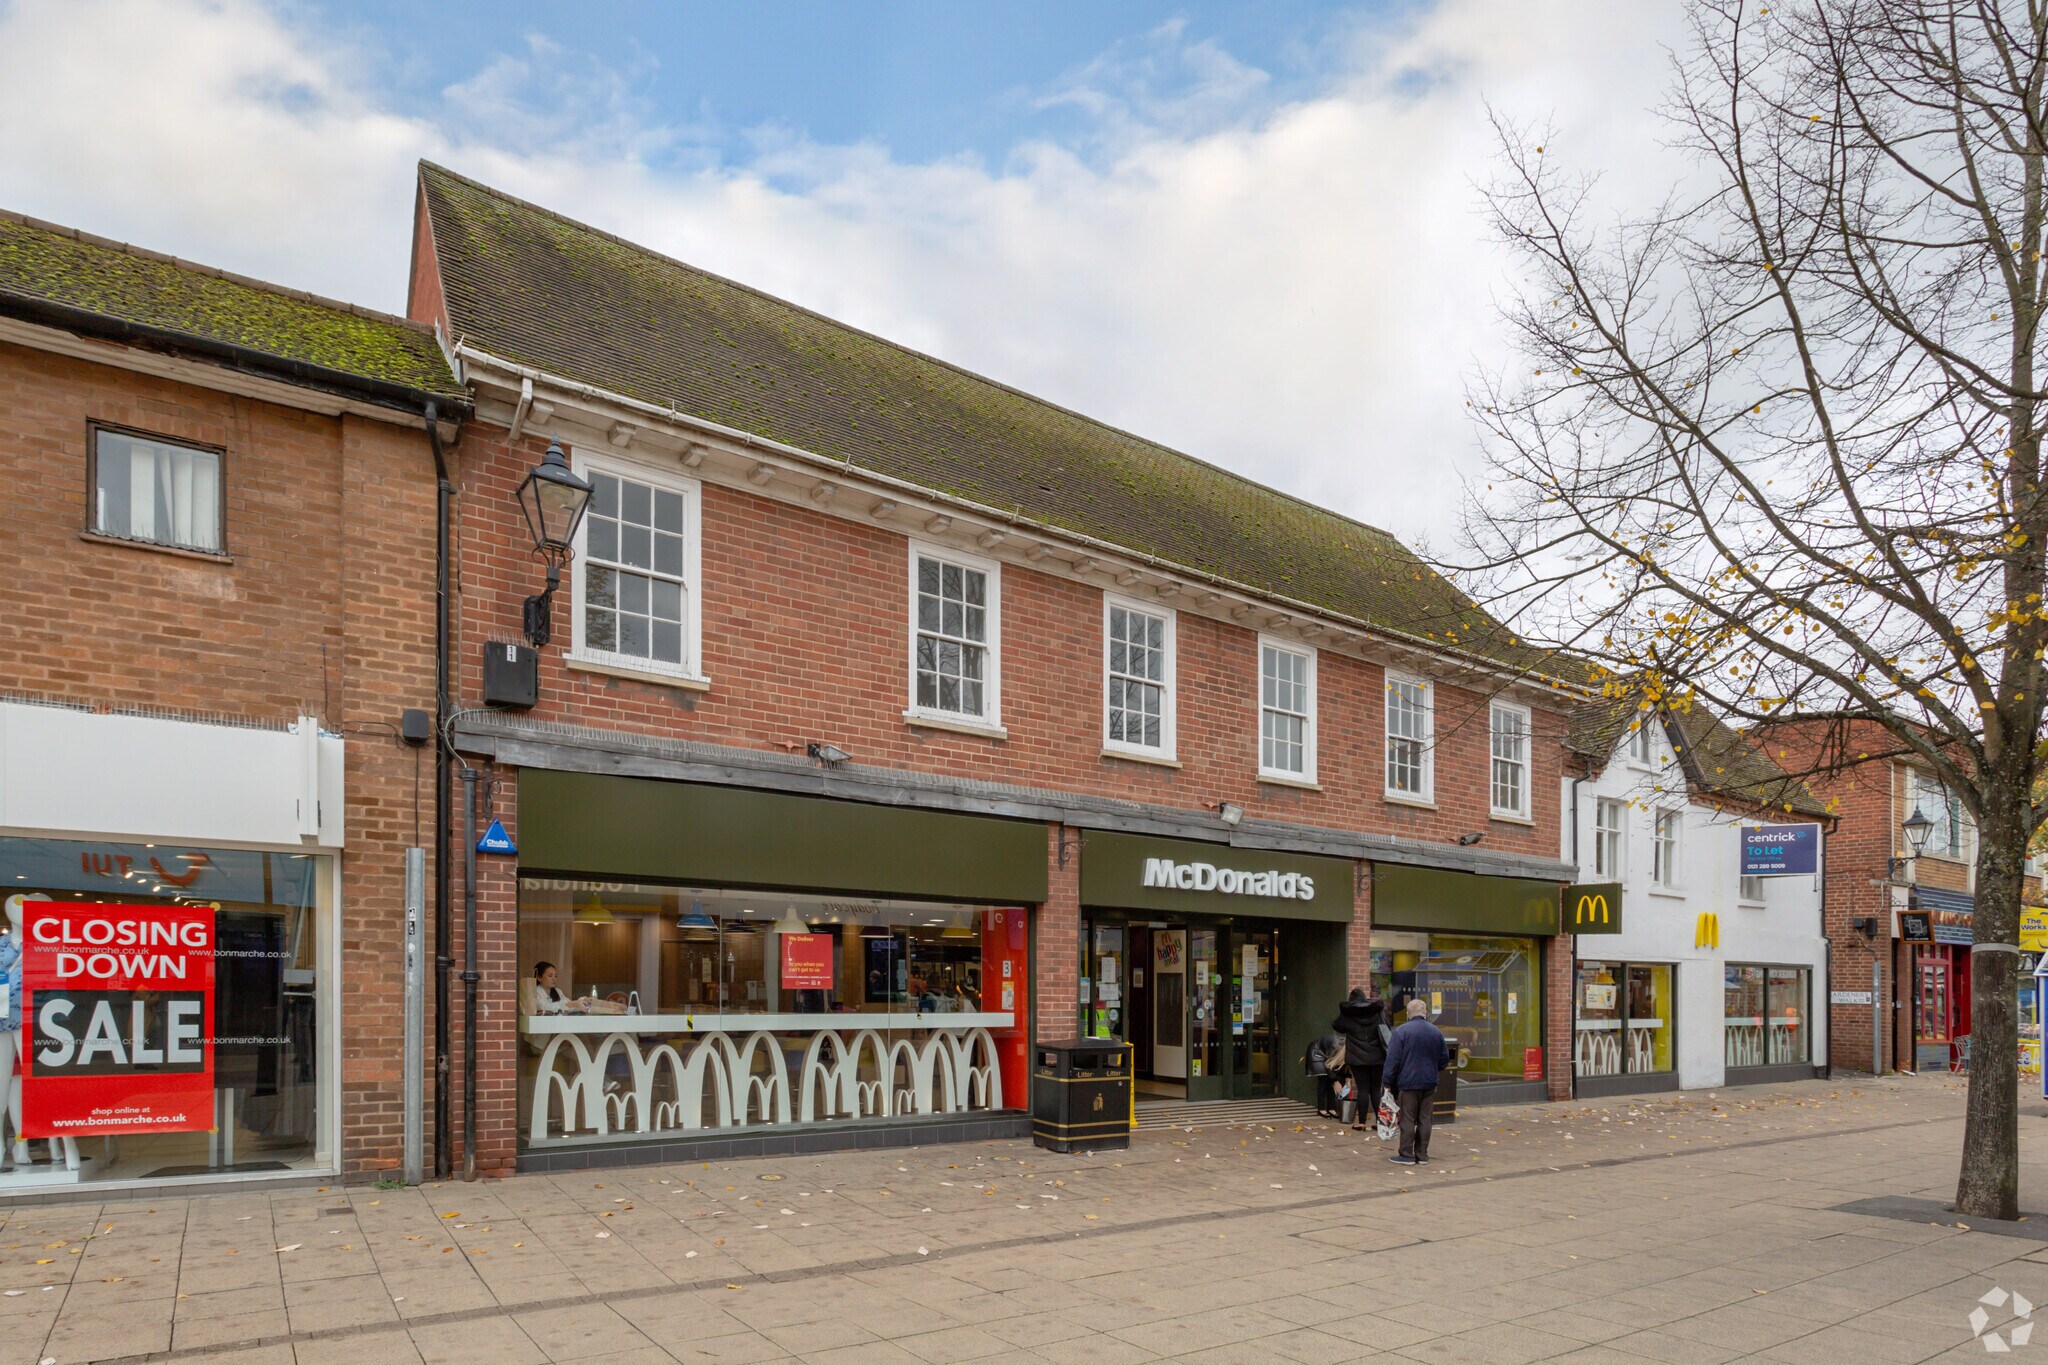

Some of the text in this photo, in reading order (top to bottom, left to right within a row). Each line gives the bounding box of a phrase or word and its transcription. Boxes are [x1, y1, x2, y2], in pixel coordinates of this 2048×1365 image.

[1747, 832, 1796, 843] centrick
[1747, 845, 1784, 856] To Let
[1143, 858, 1315, 901] McDonald's
[32, 917, 207, 947] CLOSING
[33, 945, 150, 955] www.bonmarche.co.uk
[188, 948, 292, 959] www.bonmarche.co.uk
[1157, 938, 1182, 961] happy
[57, 953, 187, 979] DOWN
[37, 998, 202, 1067] SALE
[33, 1035, 150, 1046] www.bonmarche.co.uk
[187, 1035, 292, 1045] www.bonmarche.co.uk
[1041, 1068, 1053, 1076] Litter
[91, 1107, 112, 1116] shop
[114, 1106, 139, 1114] online
[53, 1113, 187, 1127] www.bonmarche.co.uk
